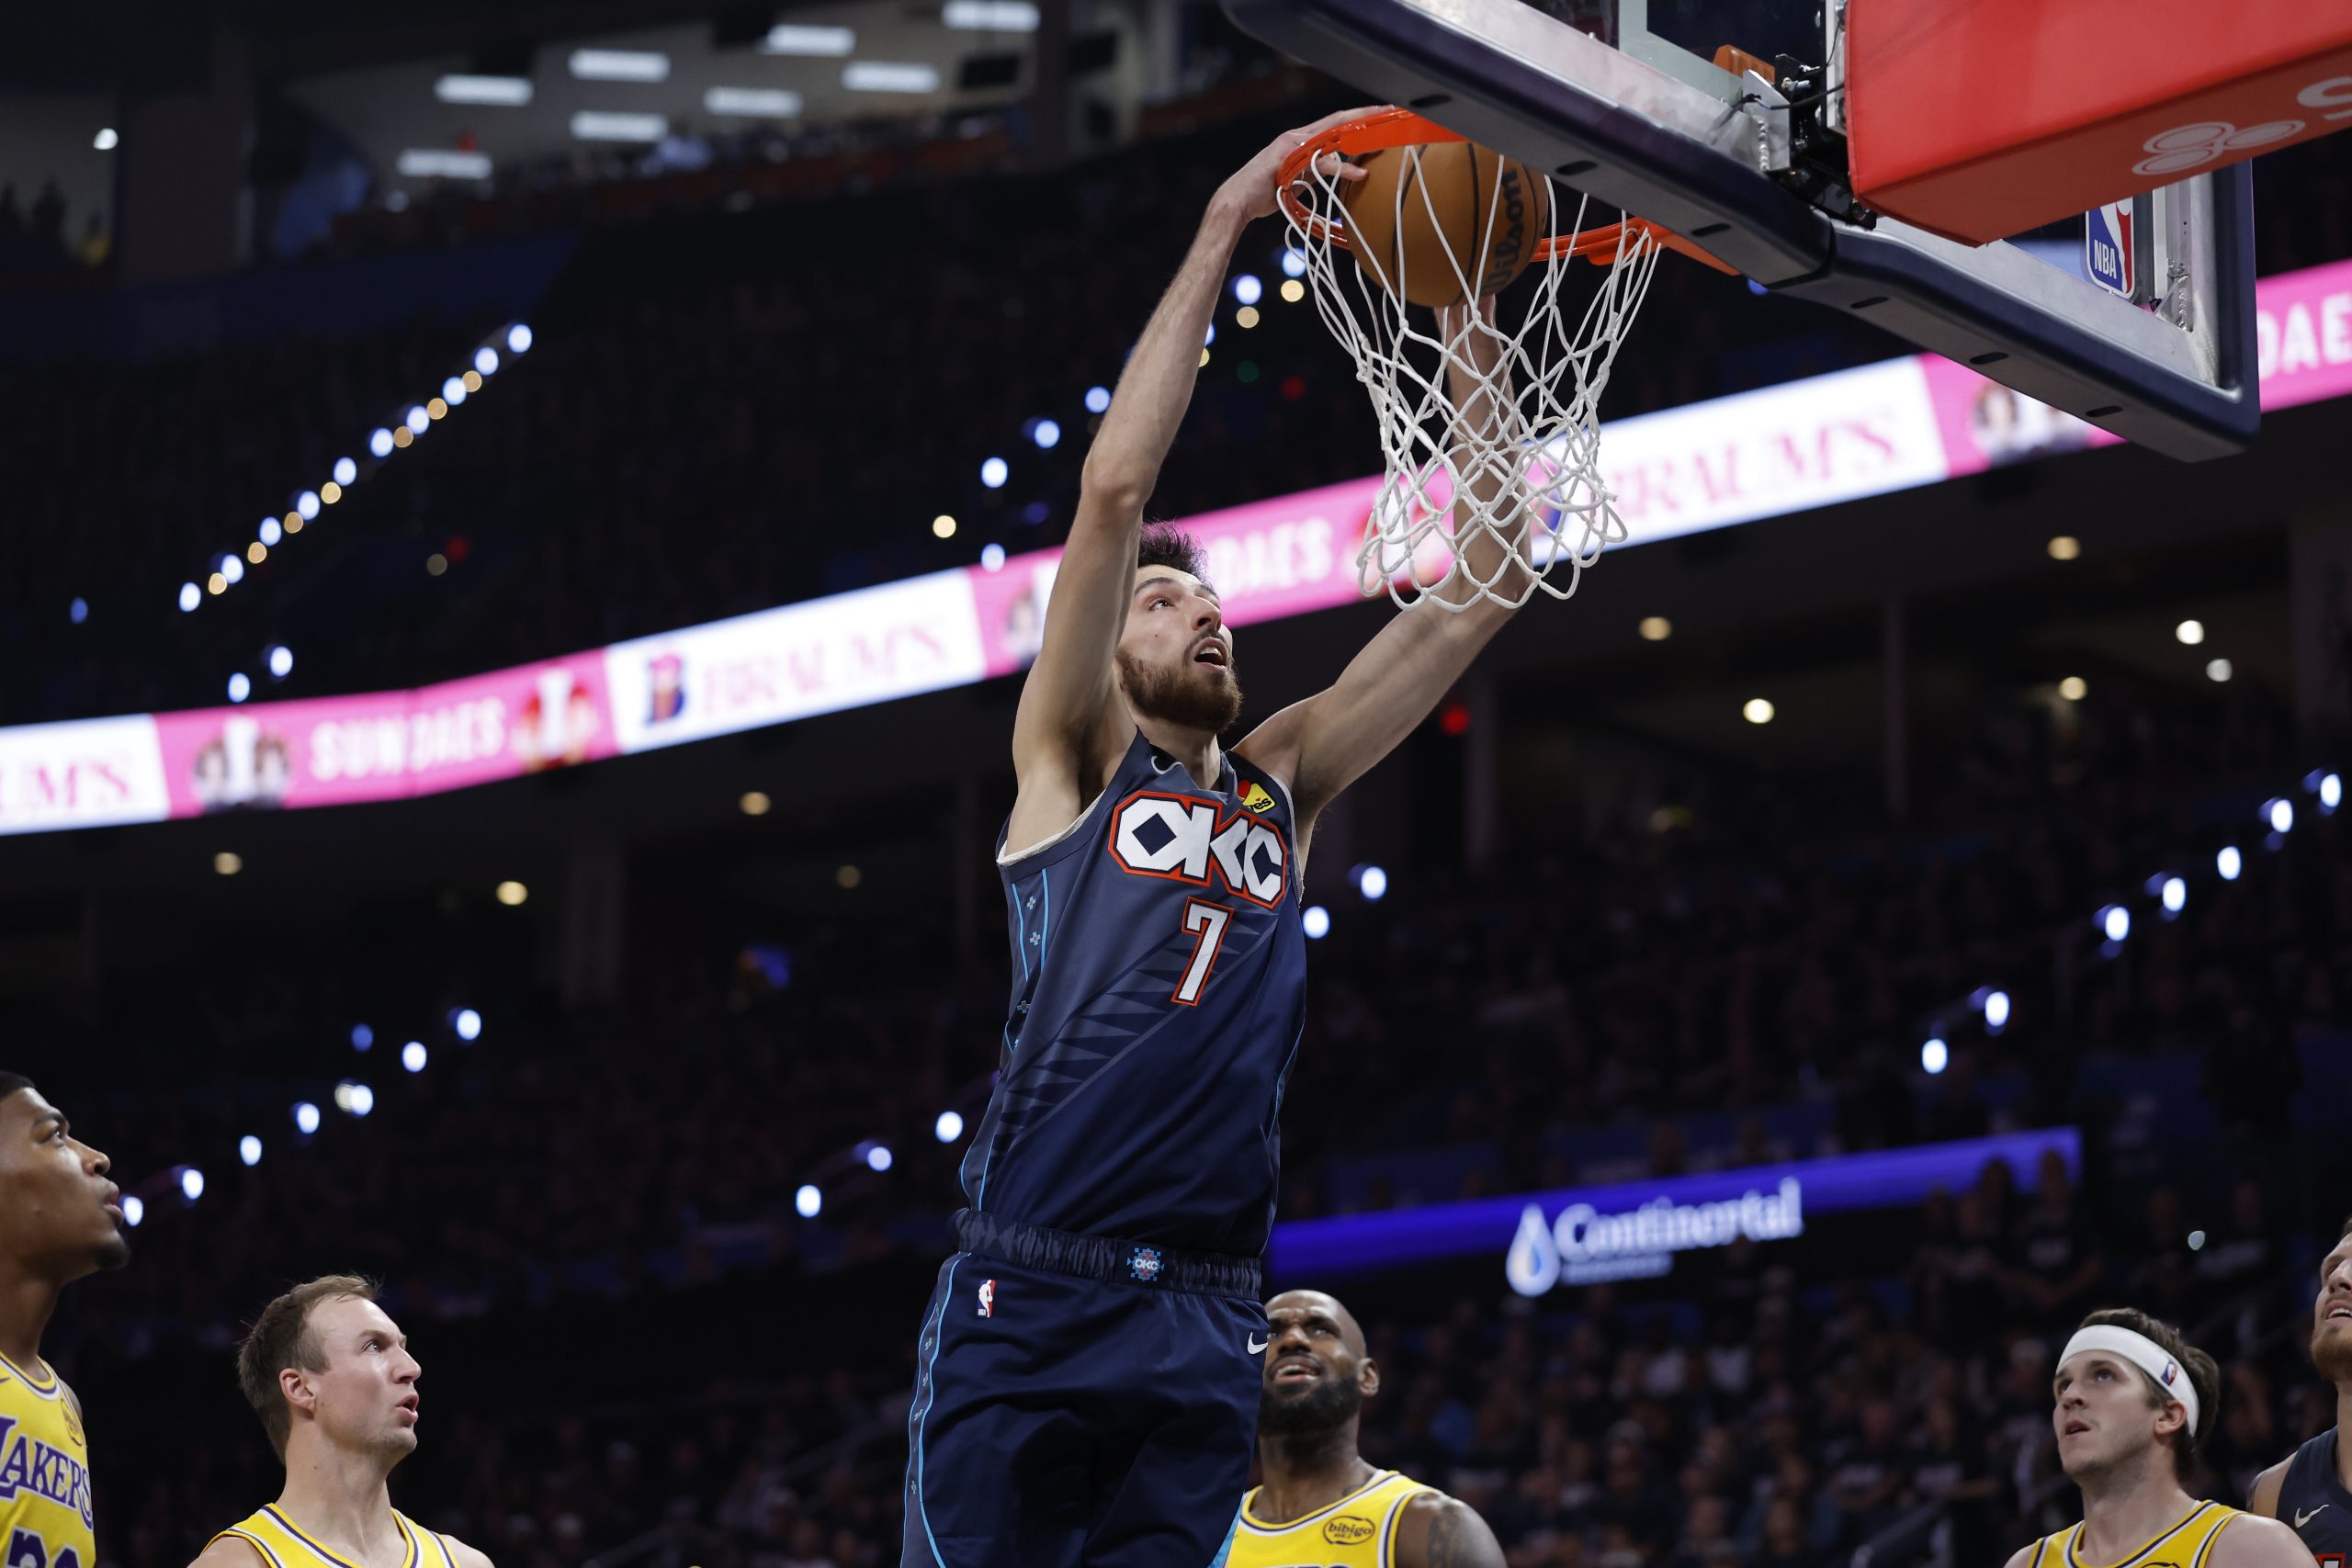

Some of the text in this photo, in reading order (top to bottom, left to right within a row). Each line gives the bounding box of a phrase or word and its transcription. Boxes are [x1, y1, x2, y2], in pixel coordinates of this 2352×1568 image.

[1473, 167, 1525, 296] Wilson
[2094, 239, 2117, 279] NBA
[1108, 790, 1287, 909] OKC
[1171, 897, 1235, 1006] 7
[1135, 1258, 1159, 1271] OKC
[1554, 1177, 1802, 1263] Continental
[0, 1416, 93, 1531] LAKERS
[1329, 1522, 1373, 1537] bibigo
